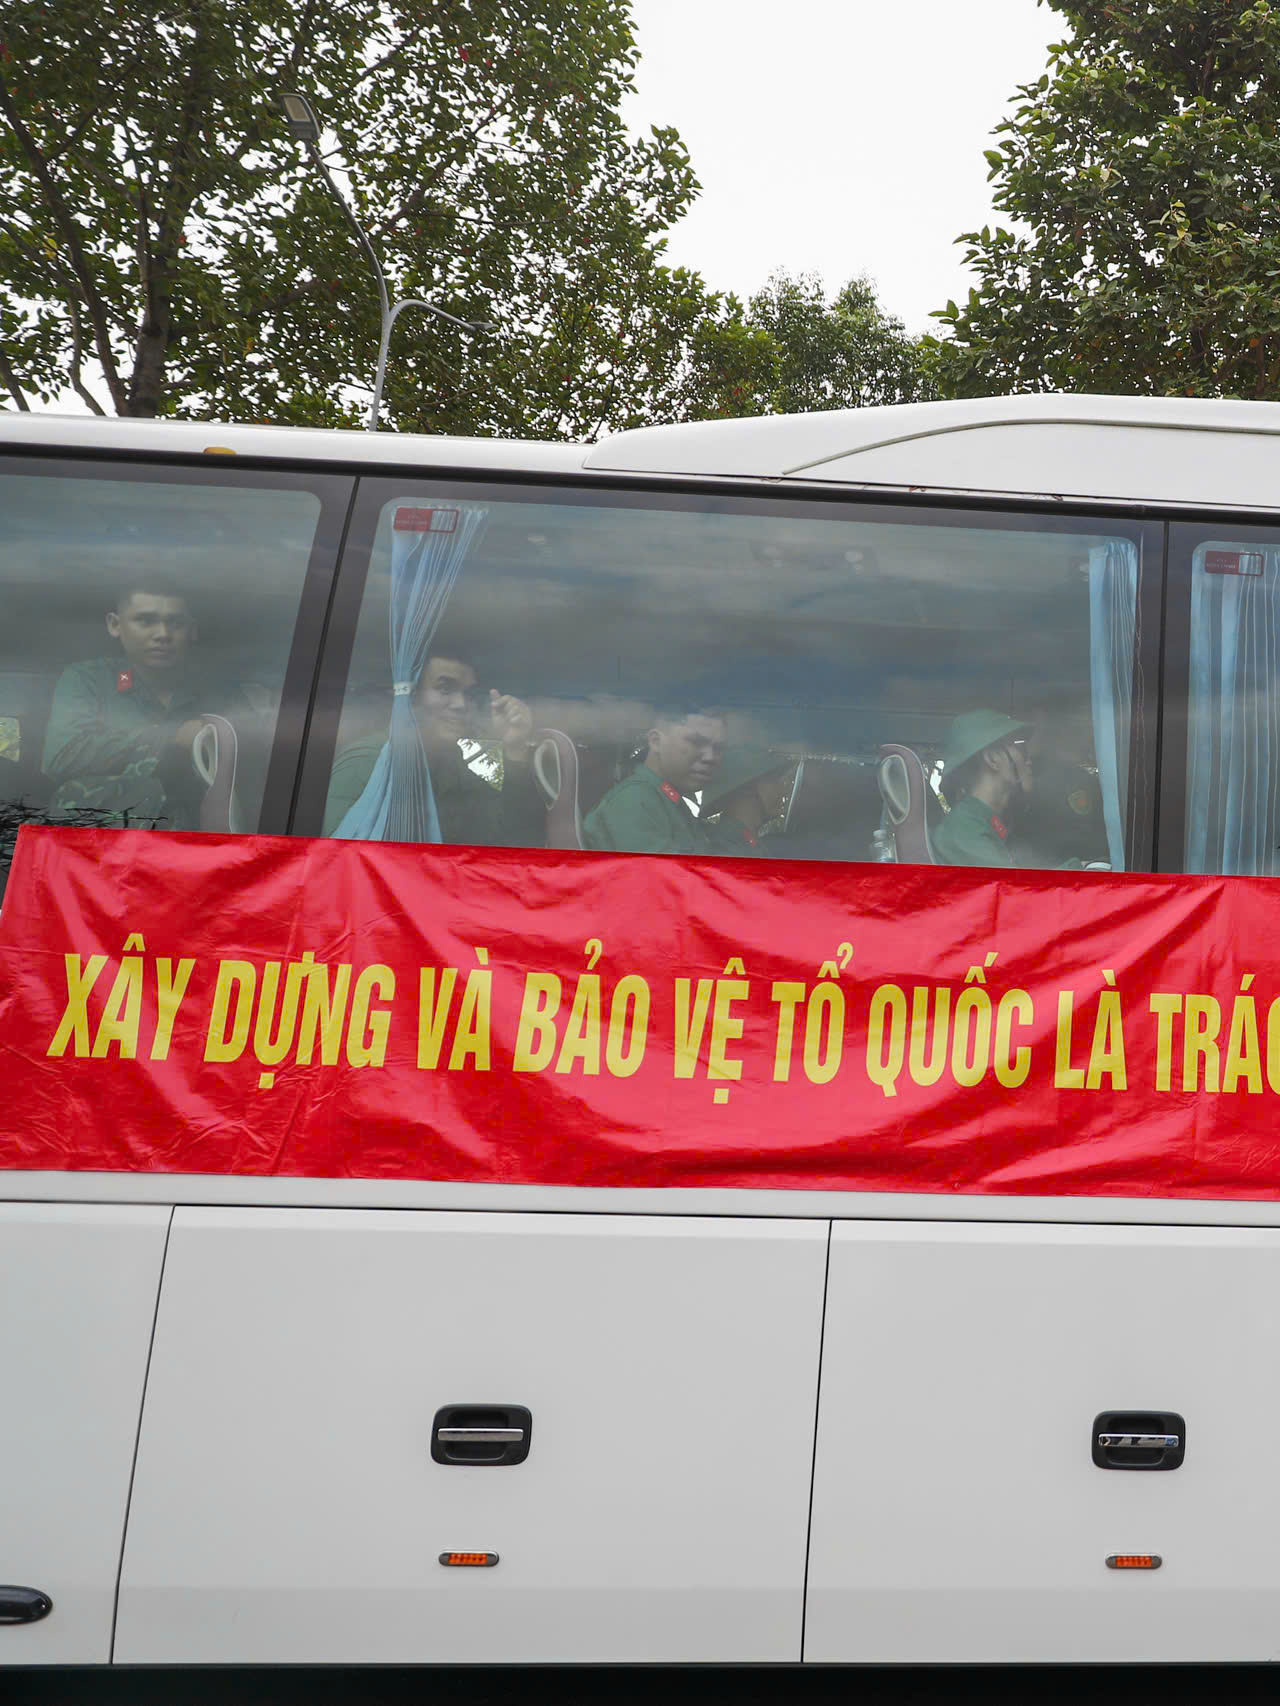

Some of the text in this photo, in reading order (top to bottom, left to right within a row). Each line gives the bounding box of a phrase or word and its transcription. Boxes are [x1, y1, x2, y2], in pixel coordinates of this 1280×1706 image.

[47, 933, 195, 1060] XÂY
[204, 951, 394, 1088] DỰNG
[417, 947, 491, 1071] VÀ
[512, 938, 649, 1077] BẢO
[673, 957, 749, 1104] VỆ
[772, 942, 853, 1084] TỔ
[866, 952, 1034, 1097] QUỐC
[1054, 969, 1127, 1091] LÀ
